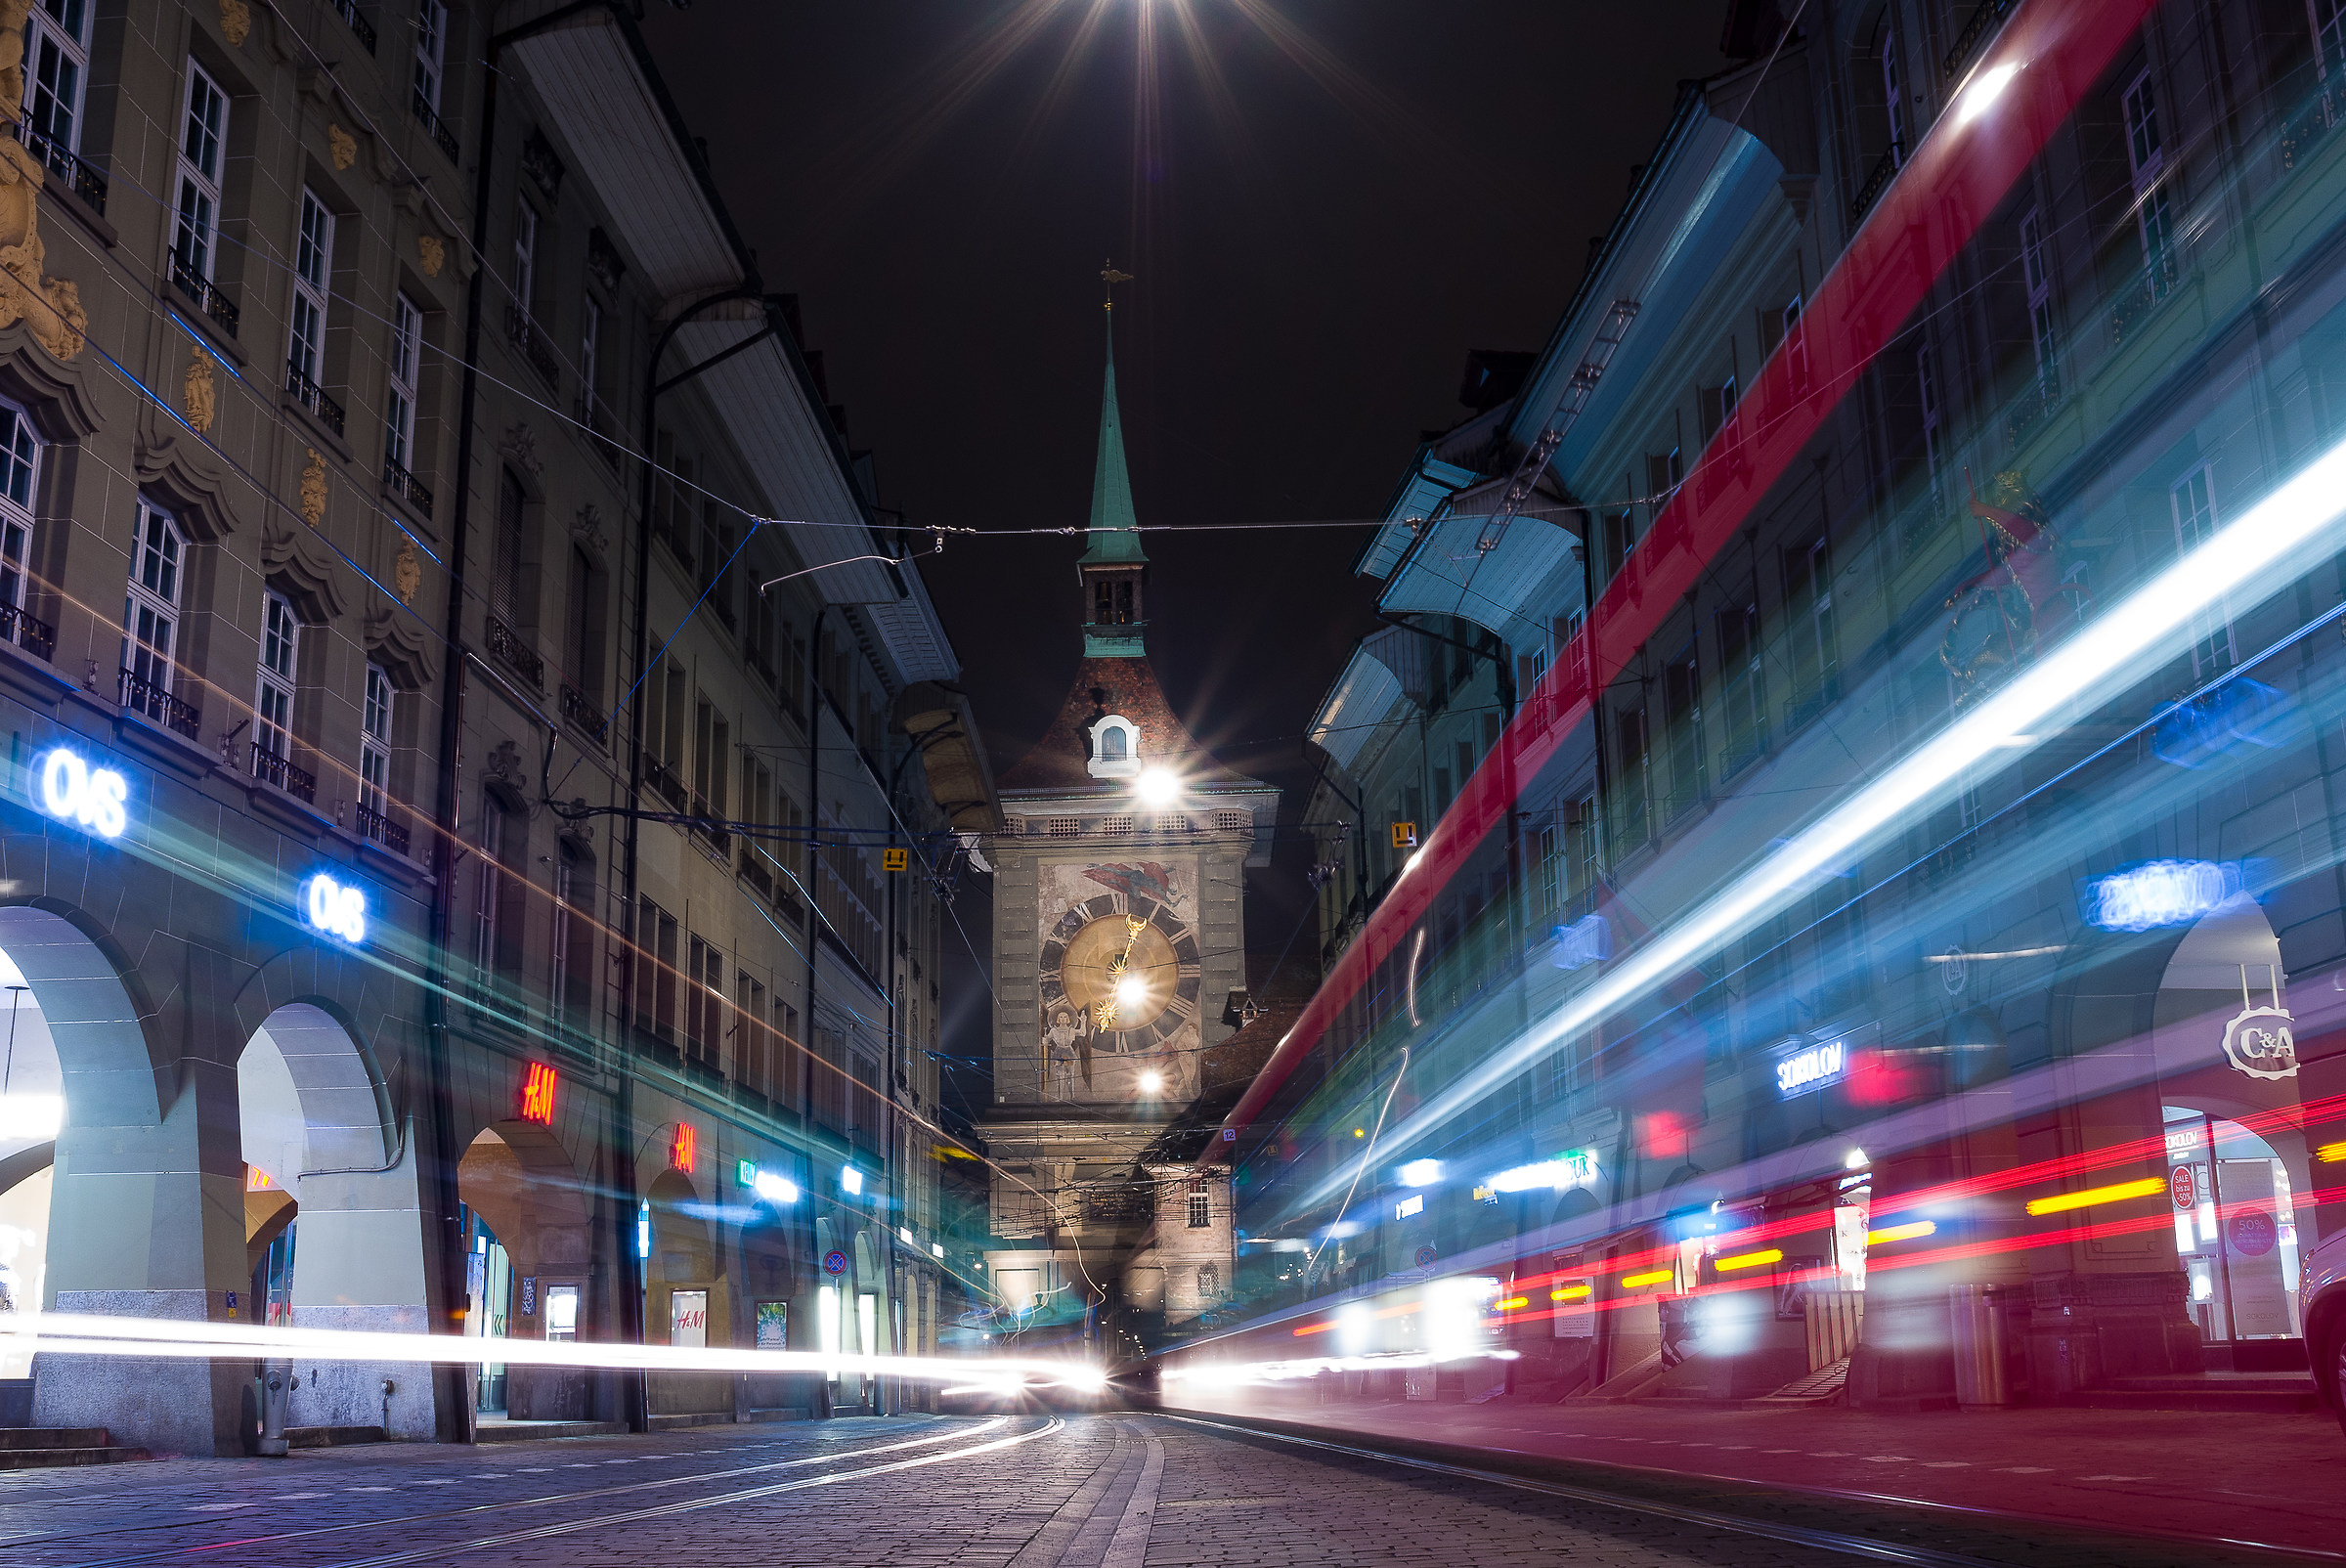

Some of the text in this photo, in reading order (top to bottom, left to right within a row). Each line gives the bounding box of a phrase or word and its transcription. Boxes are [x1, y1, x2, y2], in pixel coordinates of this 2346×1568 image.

[2240, 1026, 2295, 1059] C&A
[2175, 1174, 2190, 1184] SALE
[2238, 1219, 2266, 1231] 50%
[677, 1310, 705, 1329] H&M
